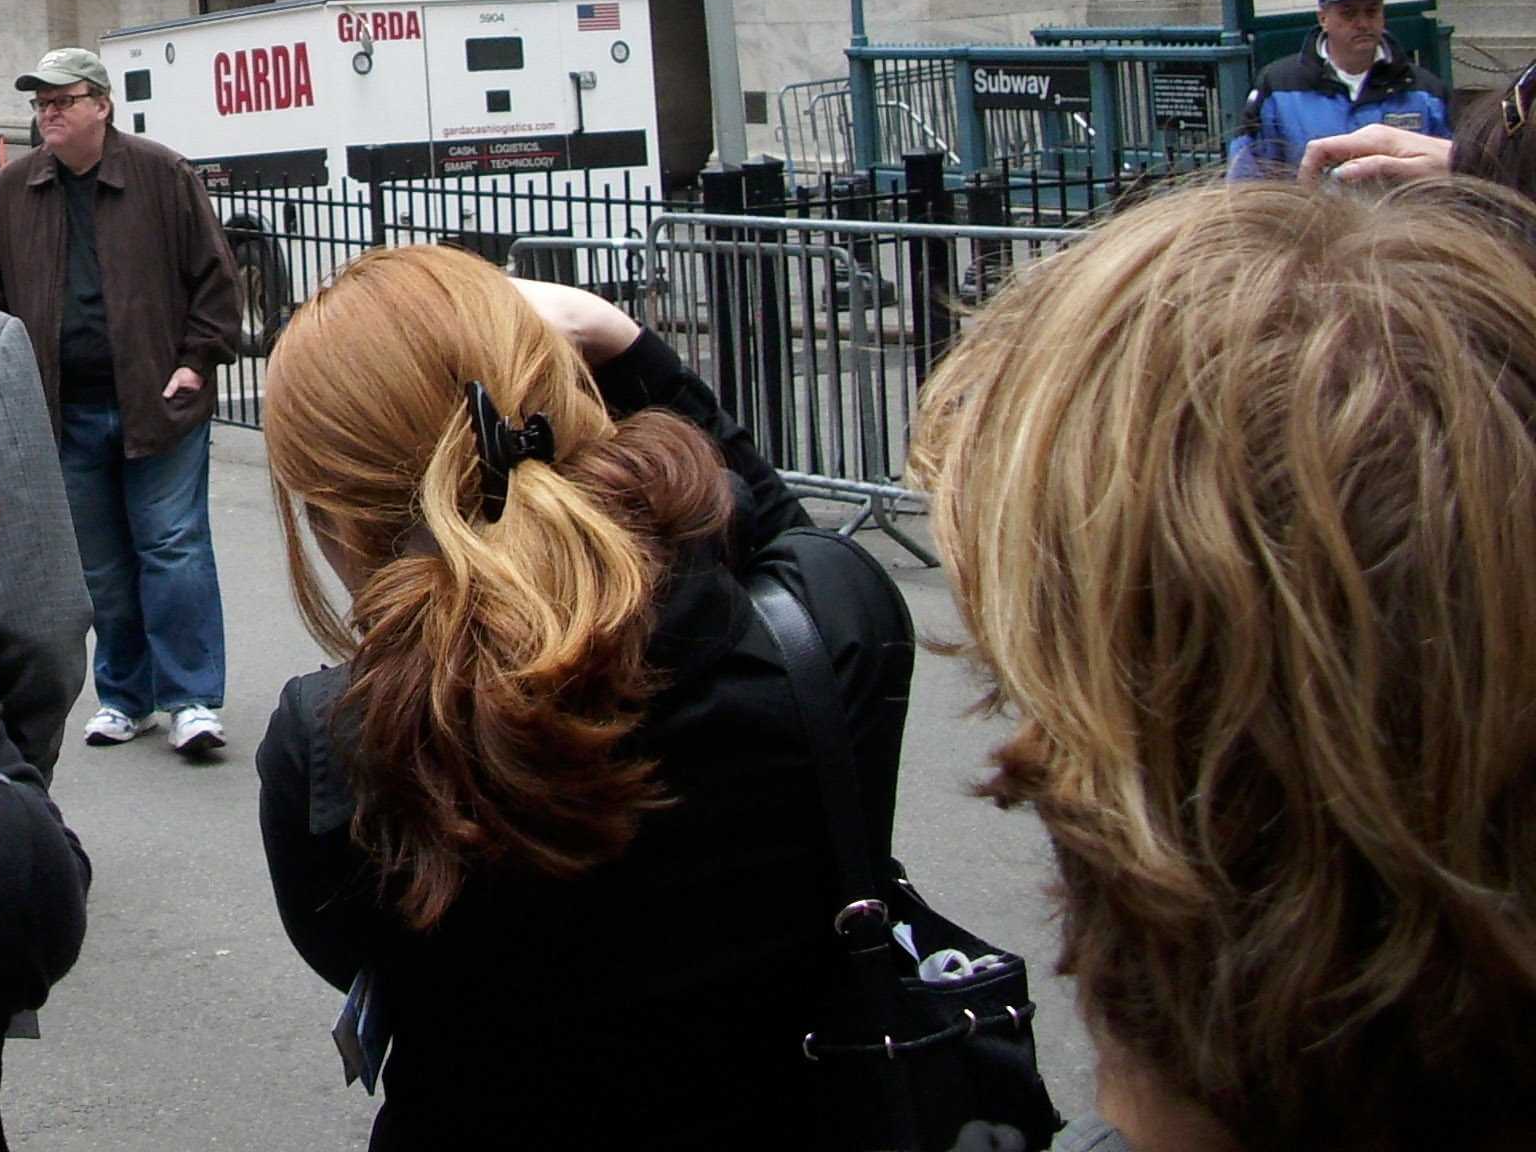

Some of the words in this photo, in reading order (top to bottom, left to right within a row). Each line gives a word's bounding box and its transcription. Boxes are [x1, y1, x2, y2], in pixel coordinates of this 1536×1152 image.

[338, 11, 422, 43] GARDA
[479, 13, 505, 24] 5904
[214, 42, 315, 116] GARDA
[974, 68, 1051, 100] Subway
[443, 121, 556, 138] gardacashlogistics.com
[490, 156, 555, 169] TECHNOLOGY
